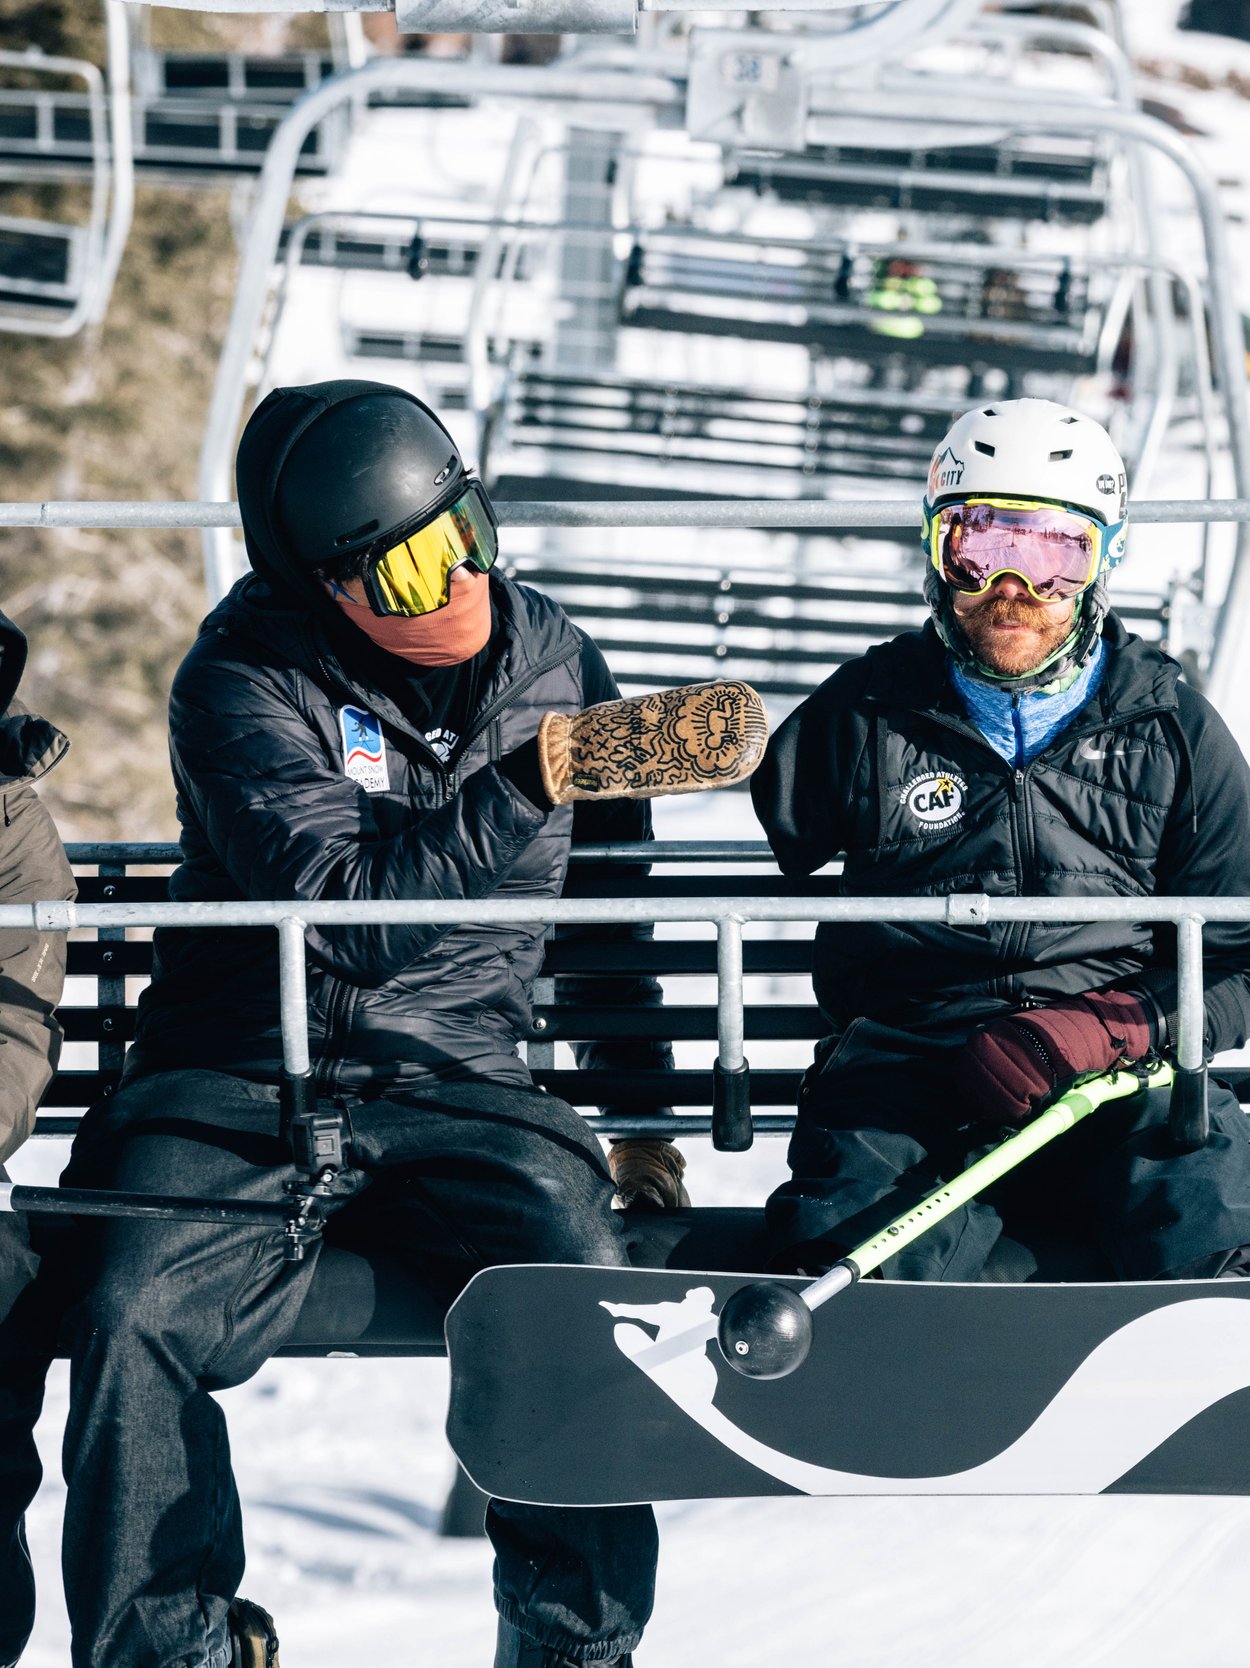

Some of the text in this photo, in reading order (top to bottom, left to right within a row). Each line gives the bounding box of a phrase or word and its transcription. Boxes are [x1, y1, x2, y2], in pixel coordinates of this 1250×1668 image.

[940, 470, 964, 486] CITY
[347, 765, 384, 776] MOUNT SNOW
[900, 771, 968, 804] CHALLENGED ATHLETES
[913, 787, 955, 813] CAF
